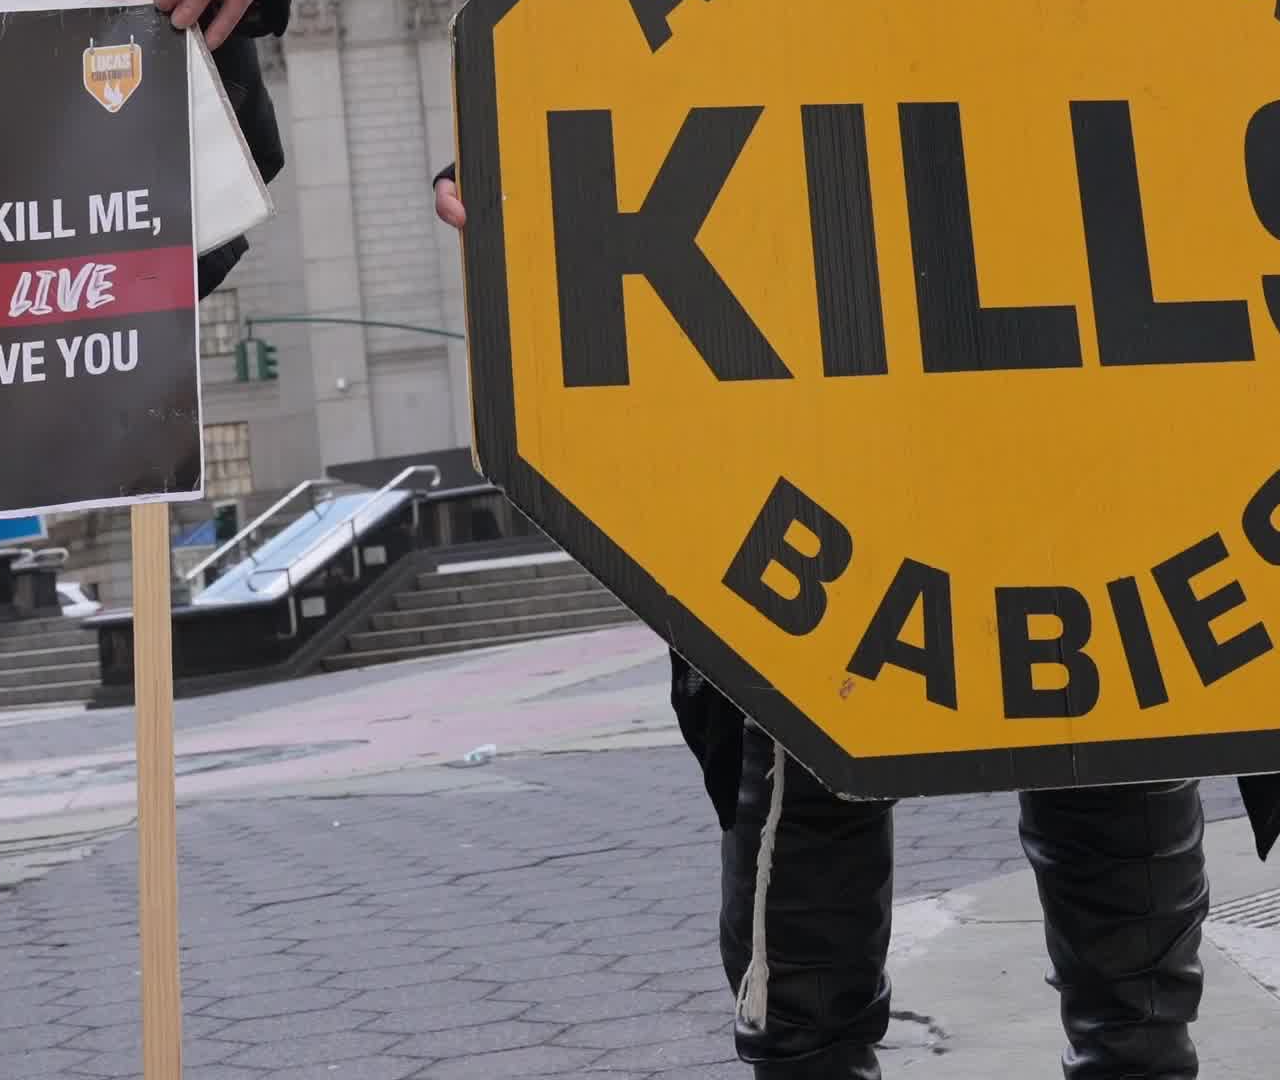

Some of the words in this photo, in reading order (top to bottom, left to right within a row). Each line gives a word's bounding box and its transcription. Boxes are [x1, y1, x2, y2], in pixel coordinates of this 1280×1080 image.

[88, 189, 161, 235] ME,
[8, 262, 117, 317] LIVE
[56, 329, 139, 378] YOU
